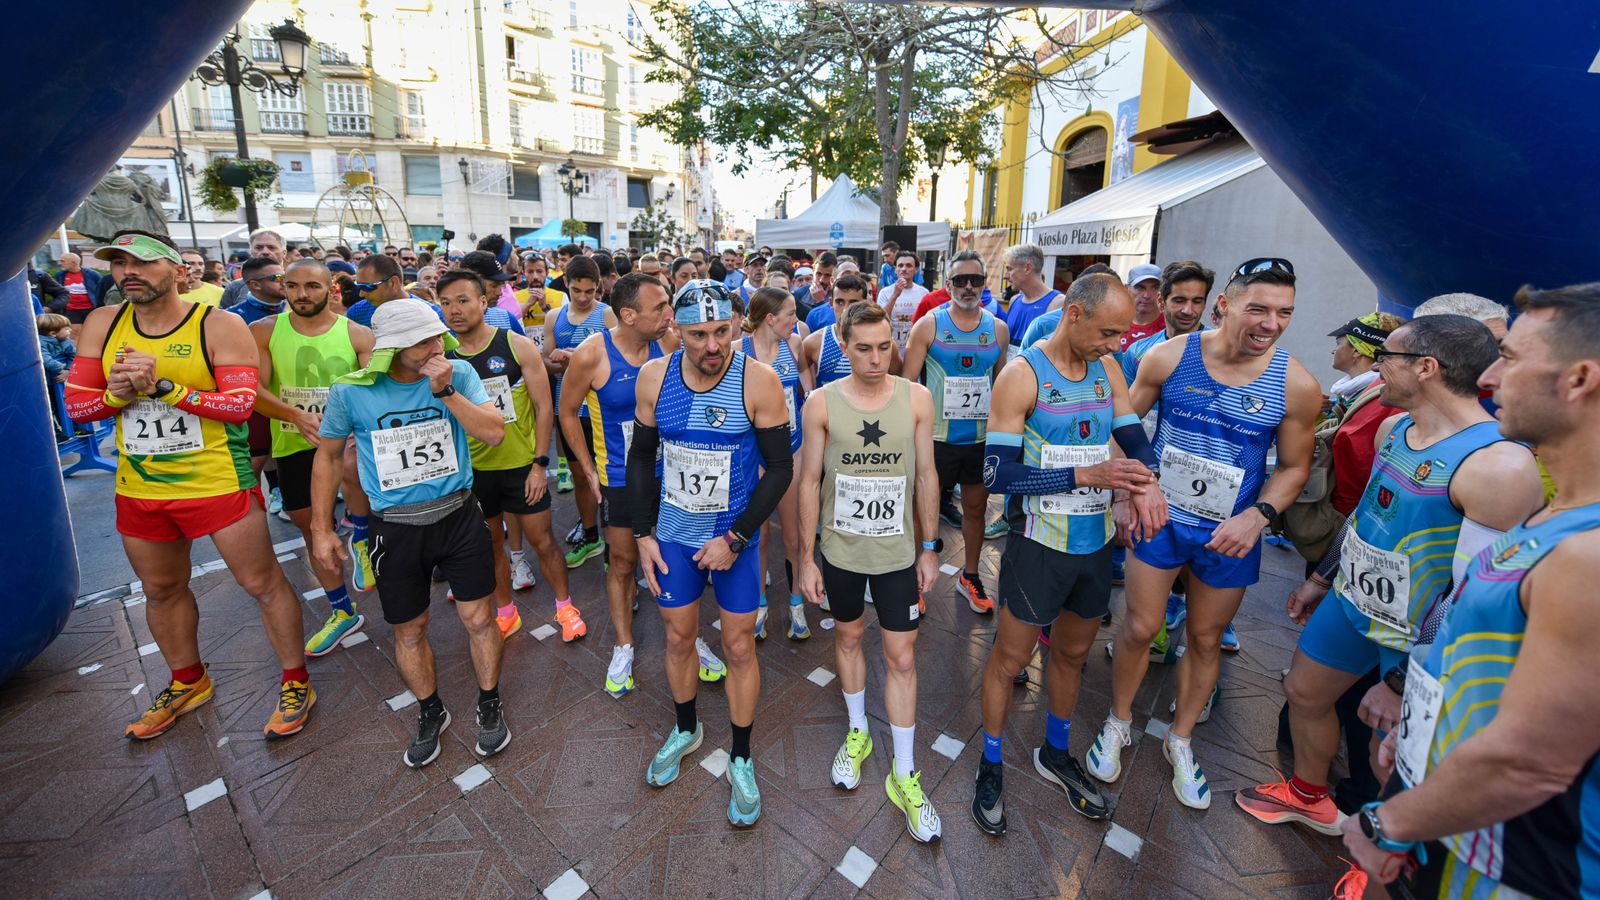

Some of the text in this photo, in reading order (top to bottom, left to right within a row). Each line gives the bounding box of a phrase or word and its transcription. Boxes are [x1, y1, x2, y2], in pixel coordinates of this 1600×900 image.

[1038, 224, 1140, 247] Kiosko Plaza Iglesia
[205, 394, 225, 402] CLUB
[962, 393, 981, 408] 27
[136, 416, 188, 438] 214
[1172, 407, 1192, 418] Club
[1192, 412, 1231, 429] Atletismo
[397, 441, 444, 469] 153
[675, 440, 709, 450] Atletismo
[711, 442, 740, 451] Linense
[841, 453, 902, 465] SAYSKY
[678, 471, 719, 497] 137
[1191, 479, 1207, 497] 9
[851, 499, 895, 521] 208
[1350, 562, 1395, 604] 160
